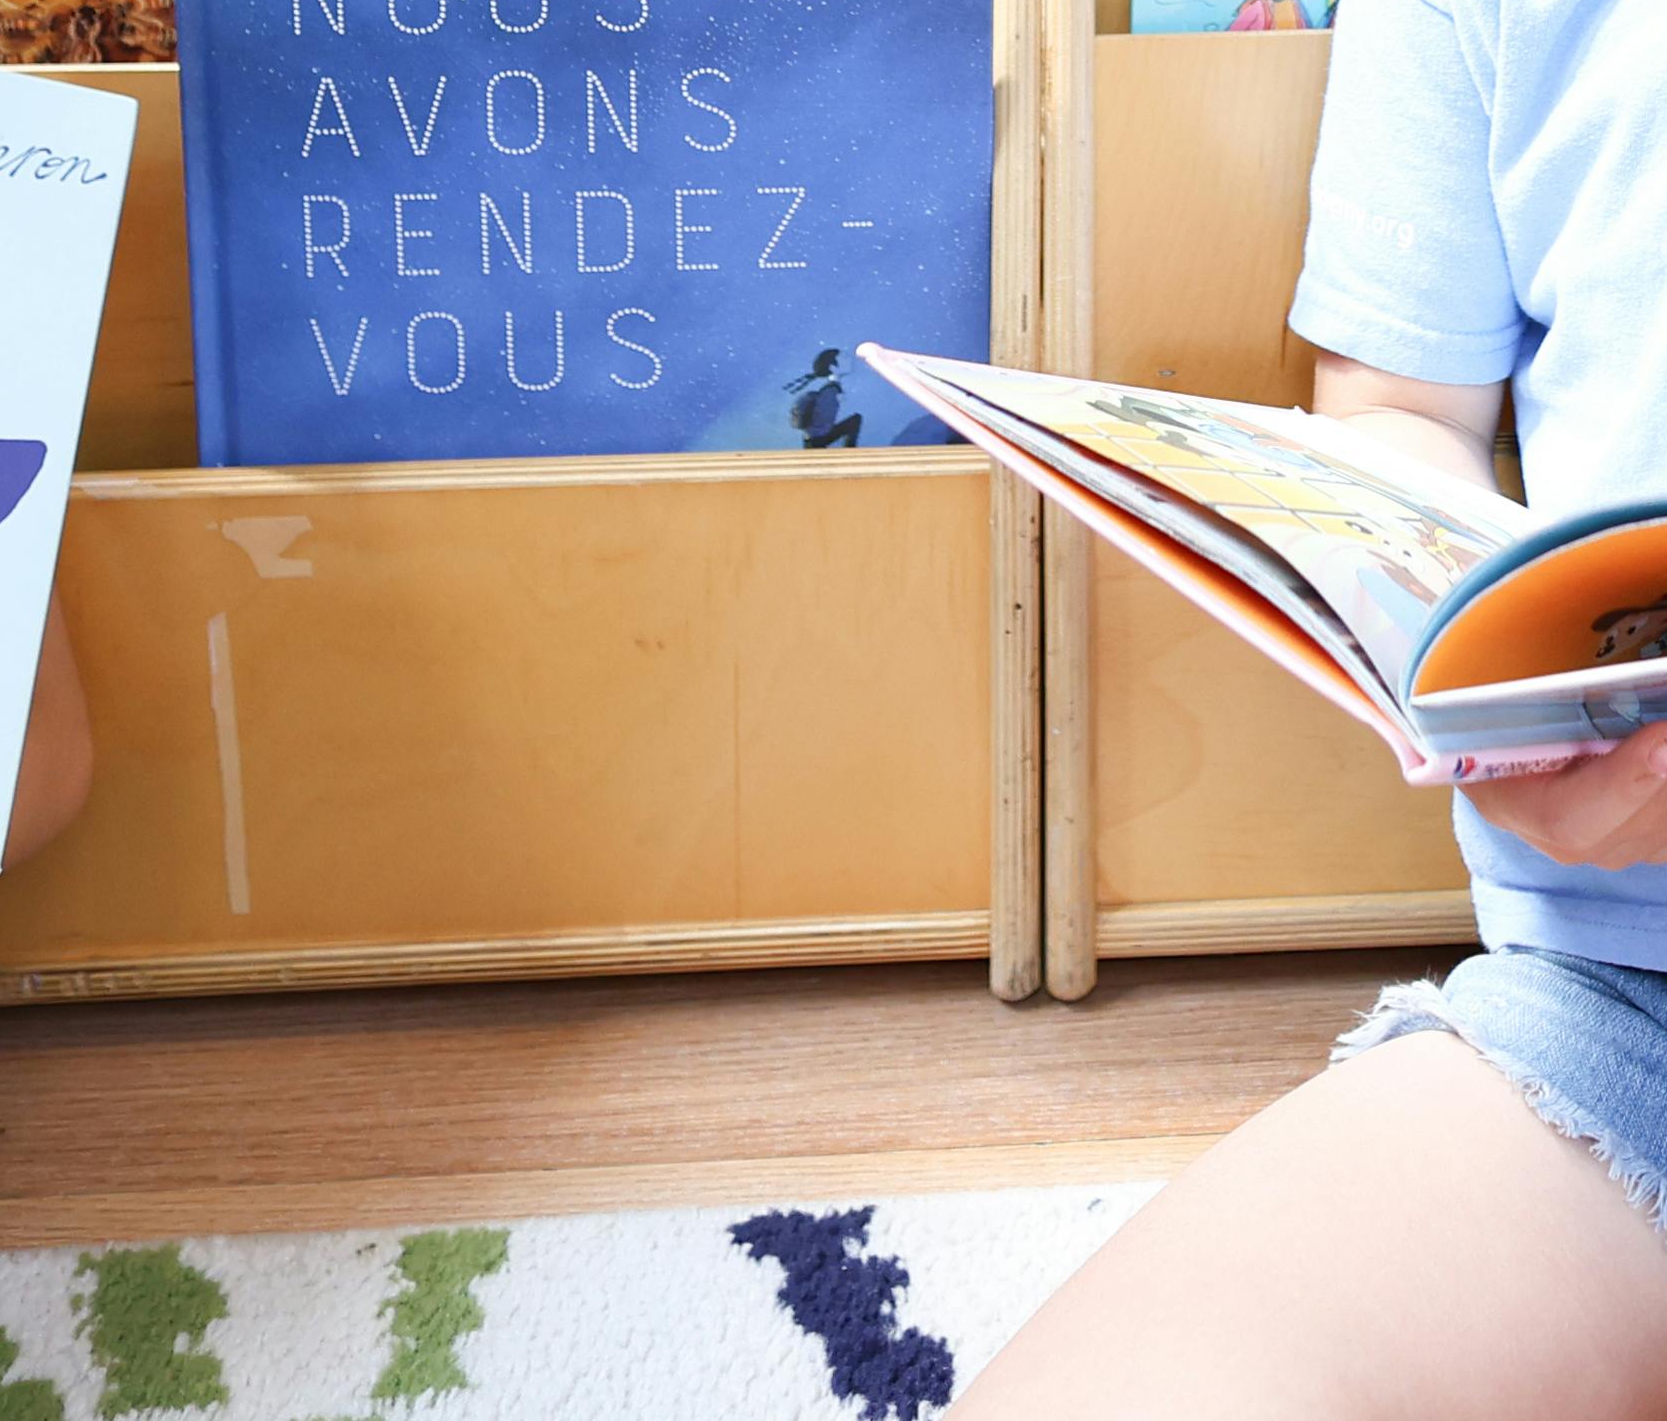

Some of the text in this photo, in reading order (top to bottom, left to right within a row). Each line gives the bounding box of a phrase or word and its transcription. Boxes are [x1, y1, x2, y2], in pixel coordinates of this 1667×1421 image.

[301, 67, 738, 158] AVONS
[303, 185, 874, 279] RENDEZ-
[310, 307, 663, 396] VOUS
